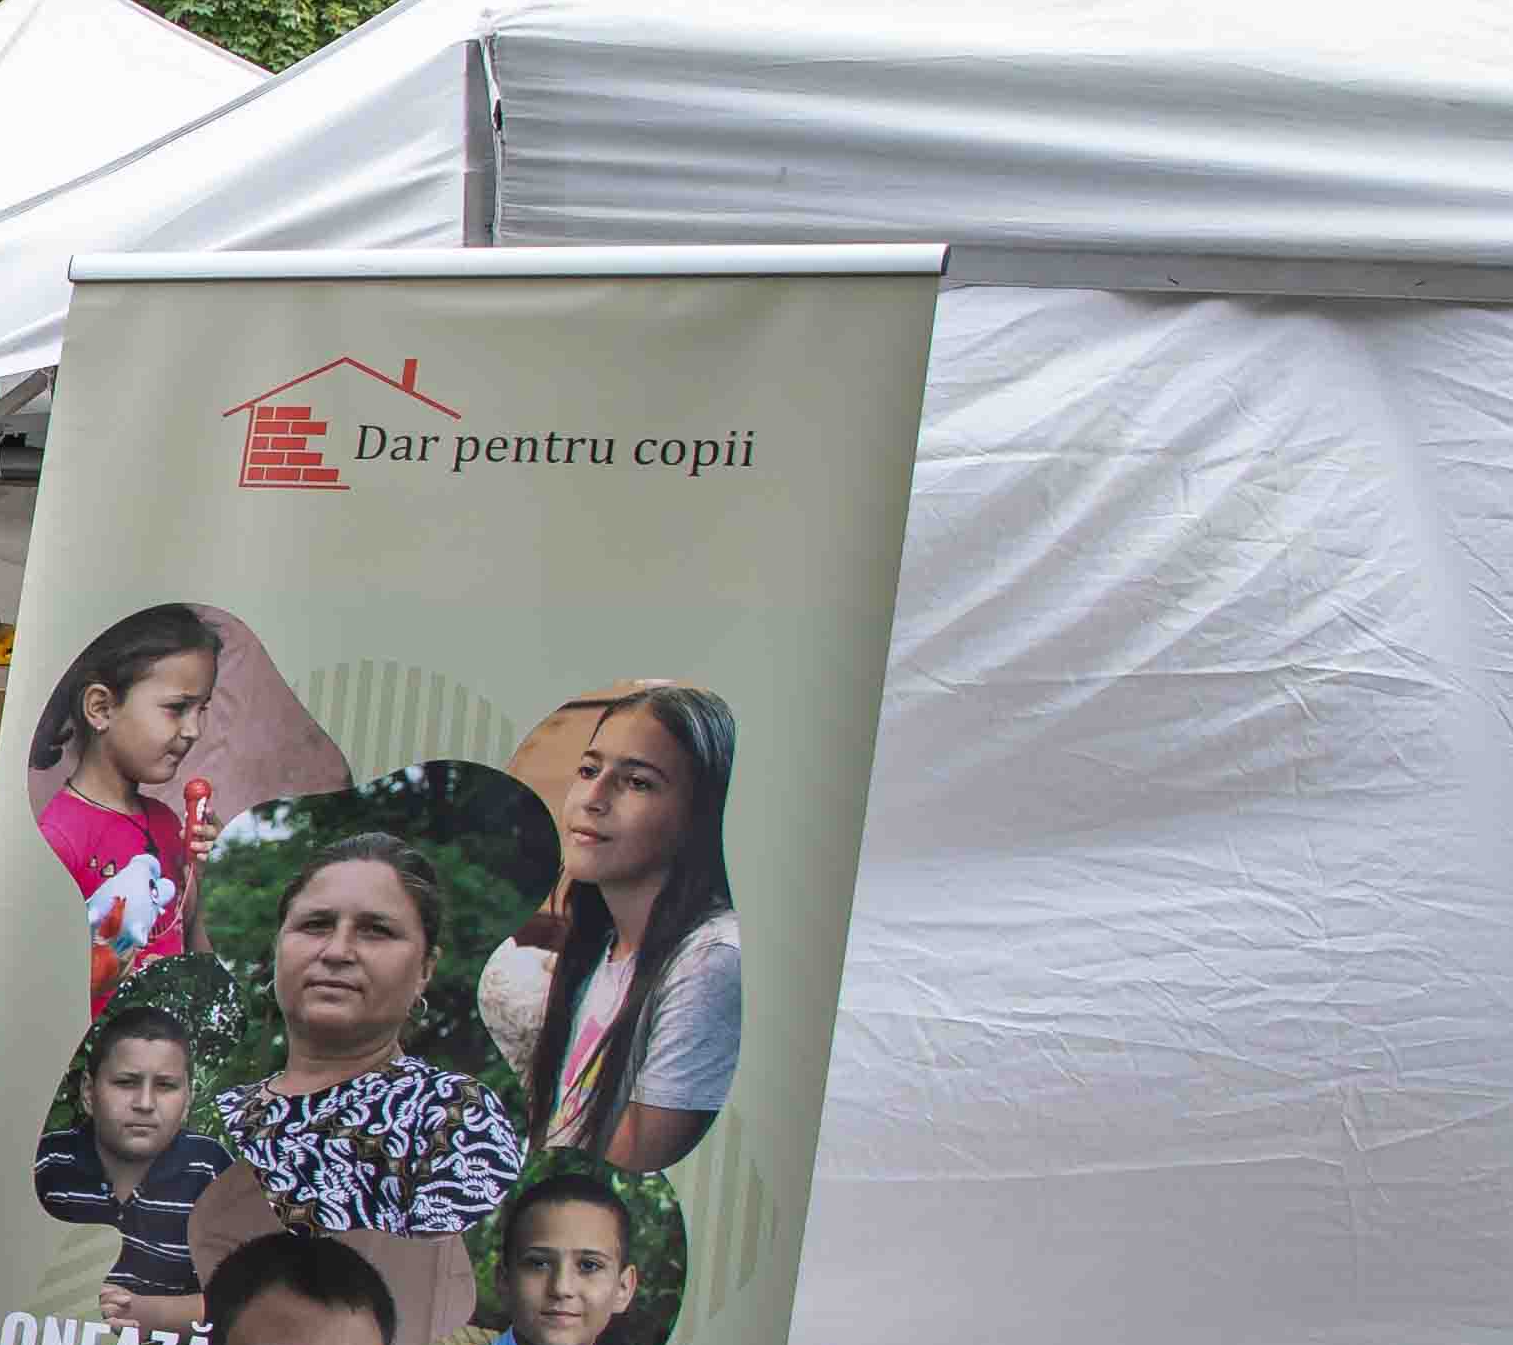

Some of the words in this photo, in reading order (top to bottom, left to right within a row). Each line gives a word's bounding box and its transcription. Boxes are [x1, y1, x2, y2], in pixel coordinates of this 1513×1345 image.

[353, 424, 440, 462] Dar
[451, 430, 617, 472] pentru
[633, 429, 758, 478] copii
